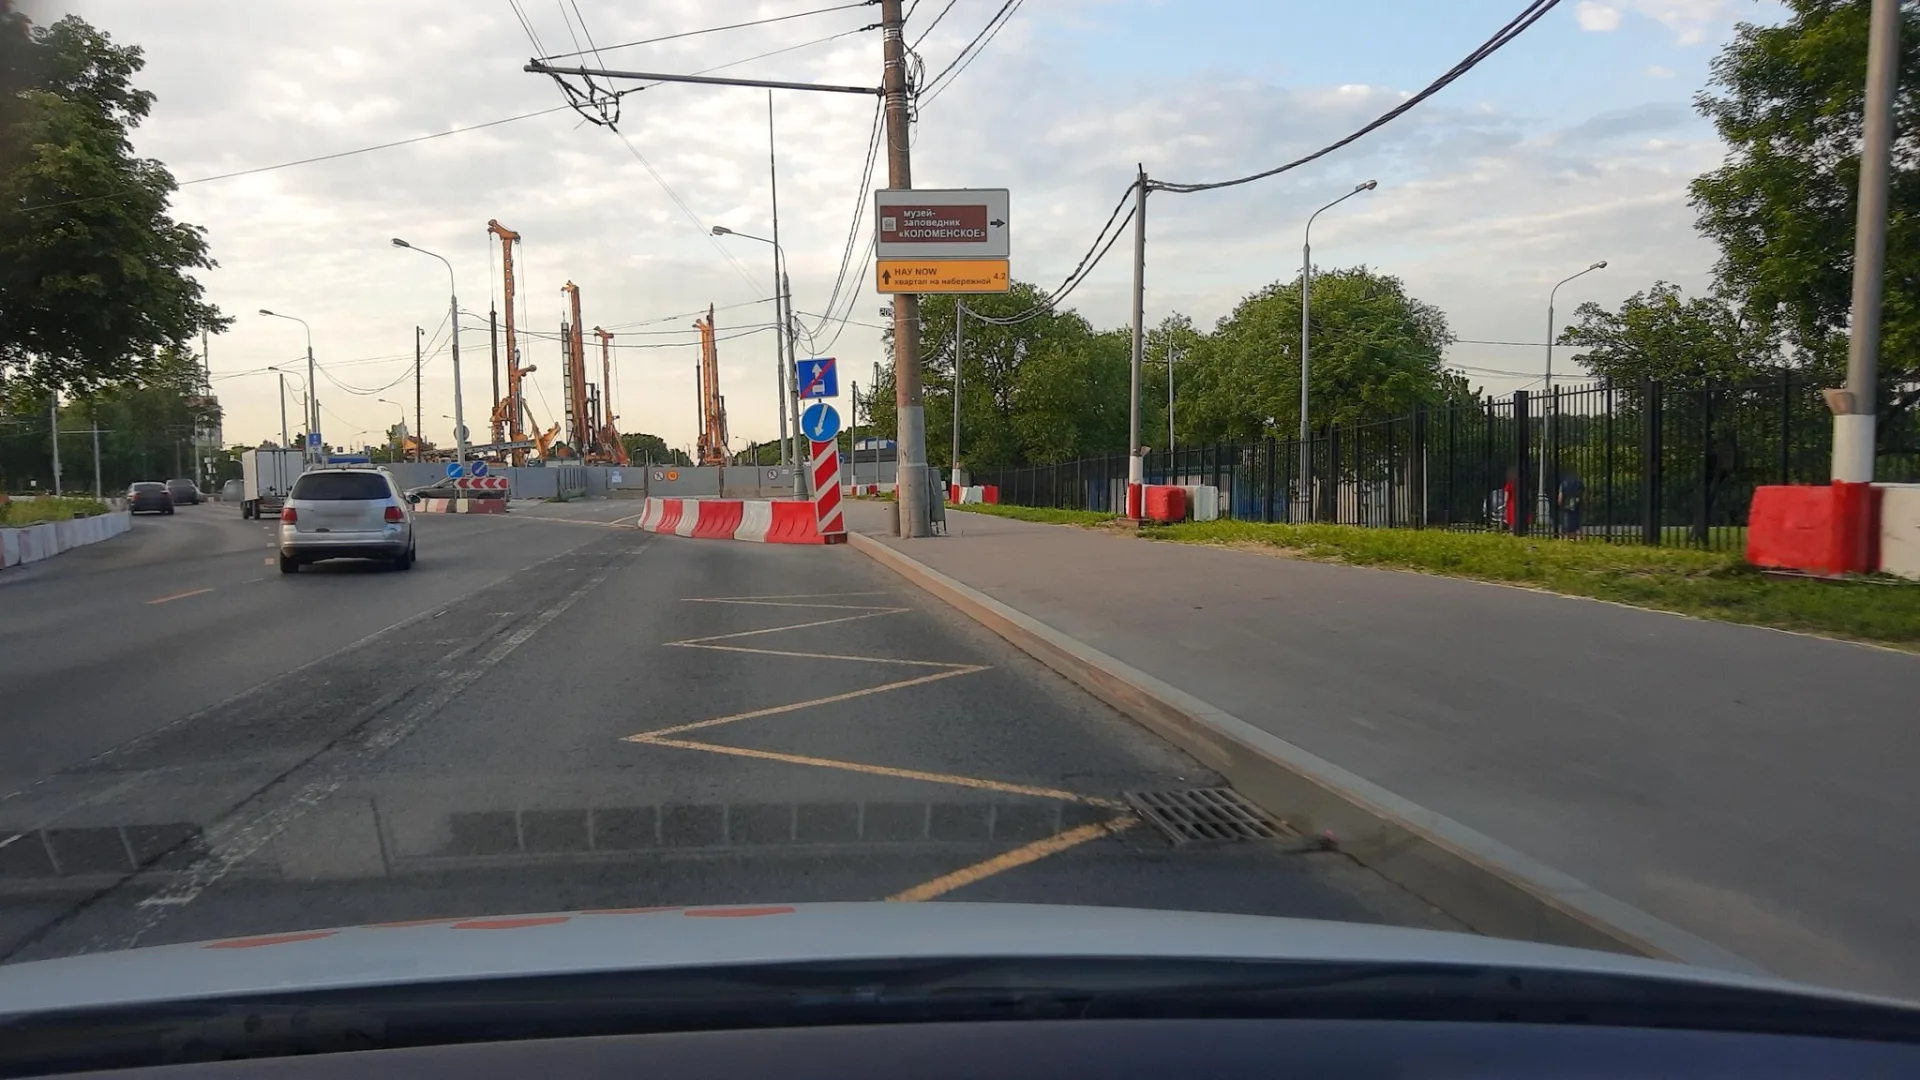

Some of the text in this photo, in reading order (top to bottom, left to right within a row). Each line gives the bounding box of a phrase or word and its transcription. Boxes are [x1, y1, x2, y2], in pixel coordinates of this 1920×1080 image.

[903, 209, 936, 218] музей-
[903, 219, 961, 227] заповедник
[899, 229, 985, 238] «КОЛОМЕНСКОЕ»
[993, 272, 1006, 280] 4.2
[894, 278, 927, 286] квартал
[941, 277, 991, 286] набережной
